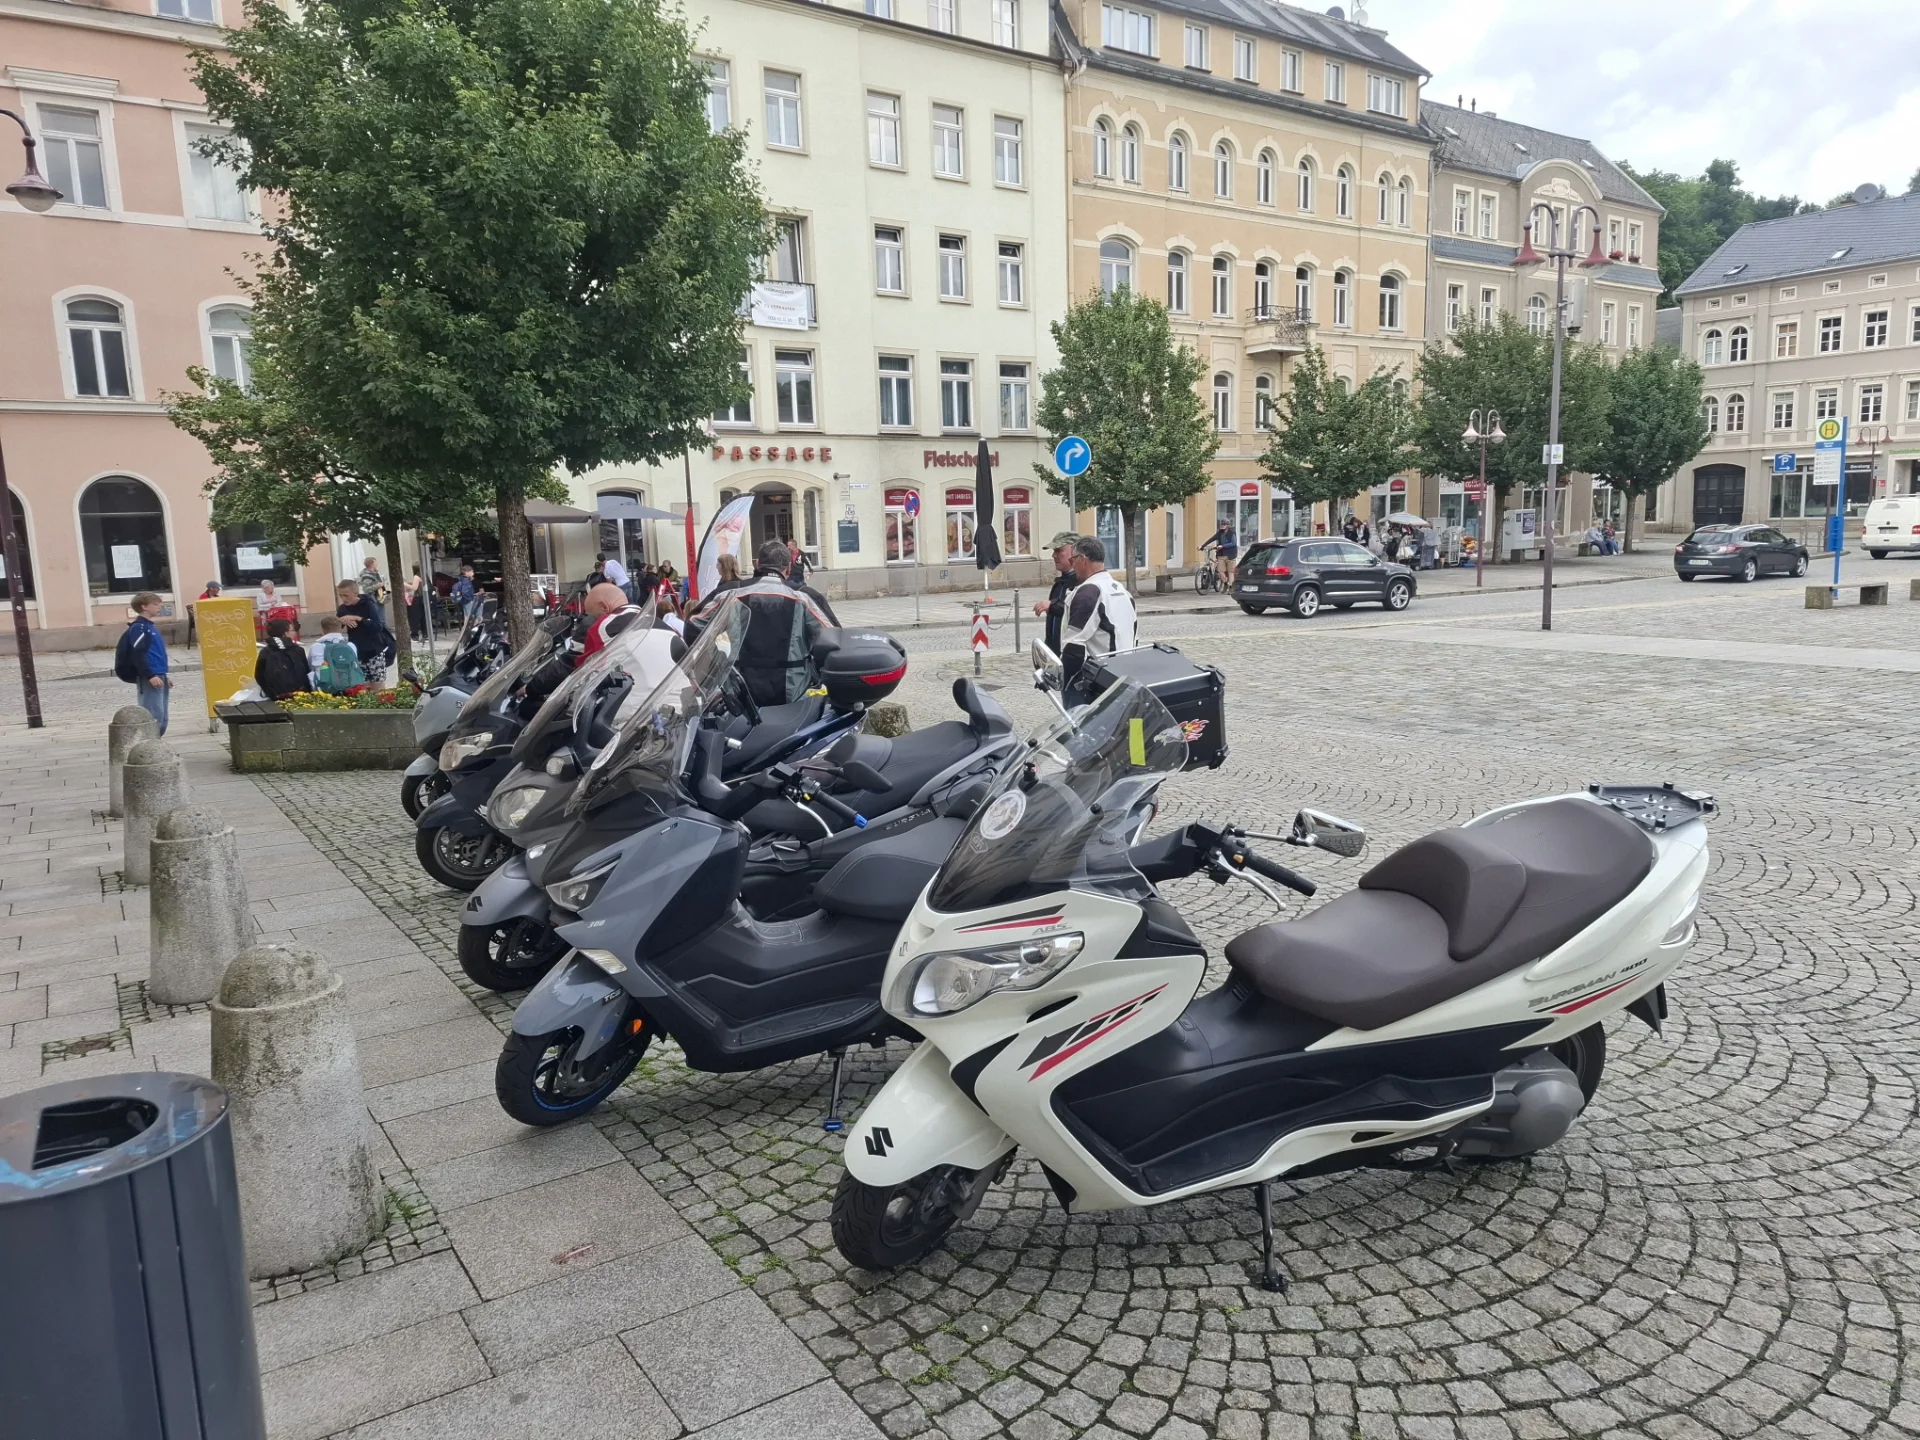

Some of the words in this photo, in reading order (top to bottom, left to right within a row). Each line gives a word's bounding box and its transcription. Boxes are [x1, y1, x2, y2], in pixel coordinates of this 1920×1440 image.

[712, 445, 832, 461] PASSAGE
[924, 450, 999, 469] Fleischeei
[1782, 457, 1789, 466] P
[587, 920, 606, 928] 300
[1032, 922, 1068, 936] ABS
[1528, 971, 1617, 1008] BURGMAN
[1620, 957, 1648, 974] 400
